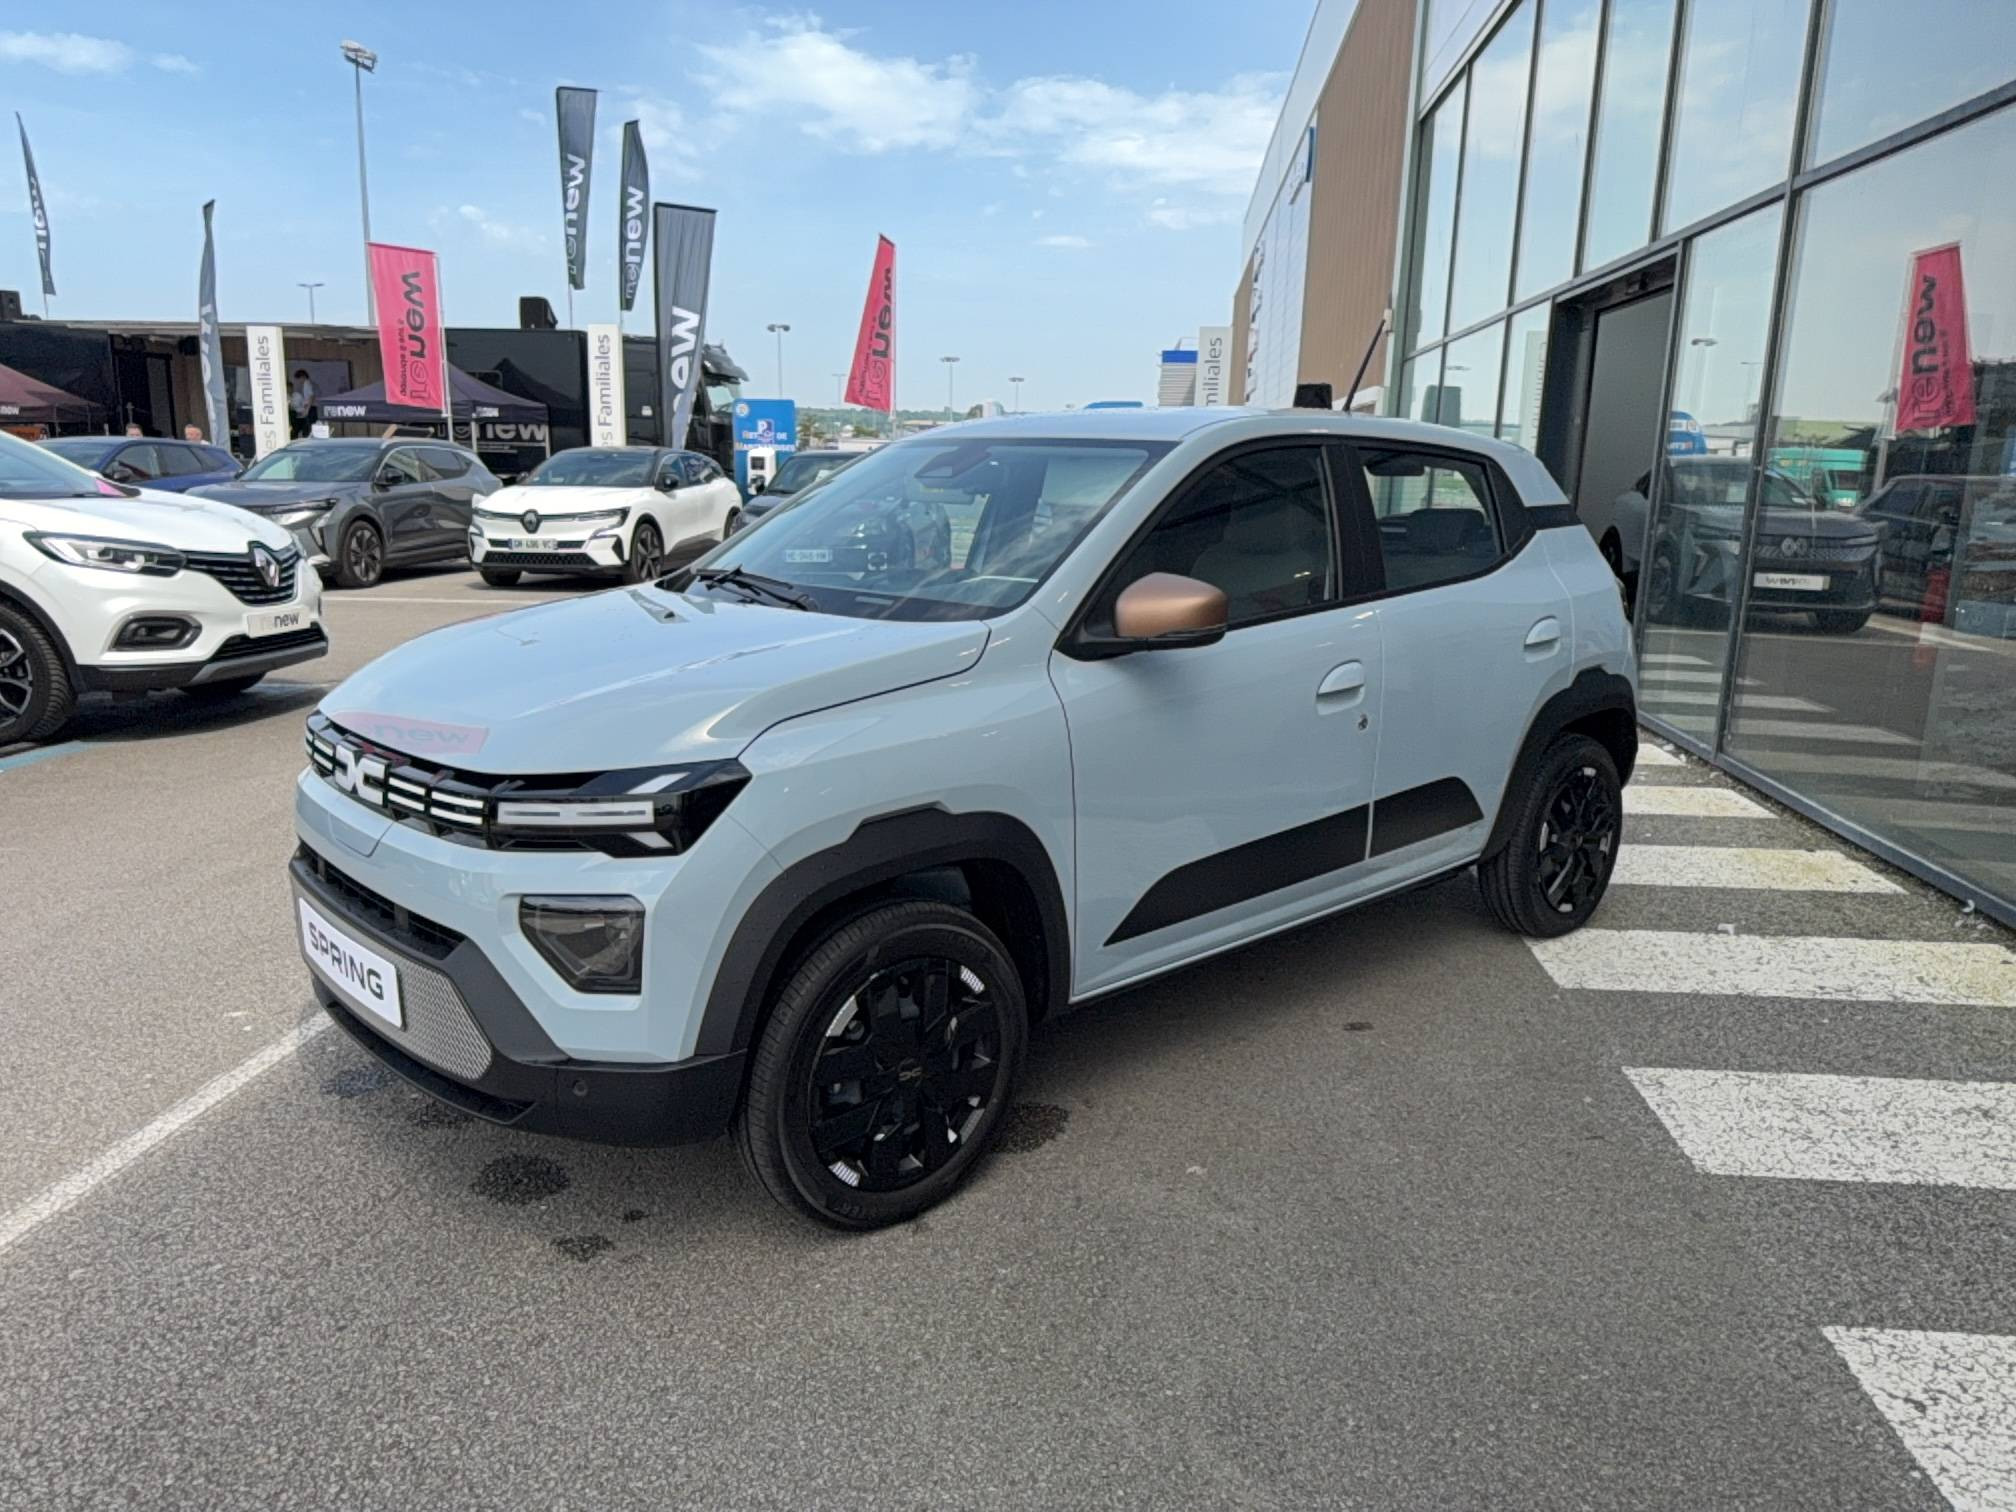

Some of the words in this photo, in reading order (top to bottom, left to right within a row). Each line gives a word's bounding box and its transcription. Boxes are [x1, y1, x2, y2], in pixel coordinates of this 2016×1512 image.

[565, 154, 586, 275] renew
[256, 335, 274, 425] Familiales
[594, 334, 613, 427] Familiales
[1911, 274, 1942, 421] renew
[323, 405, 367, 417] renew
[309, 921, 384, 1001] SPRING
